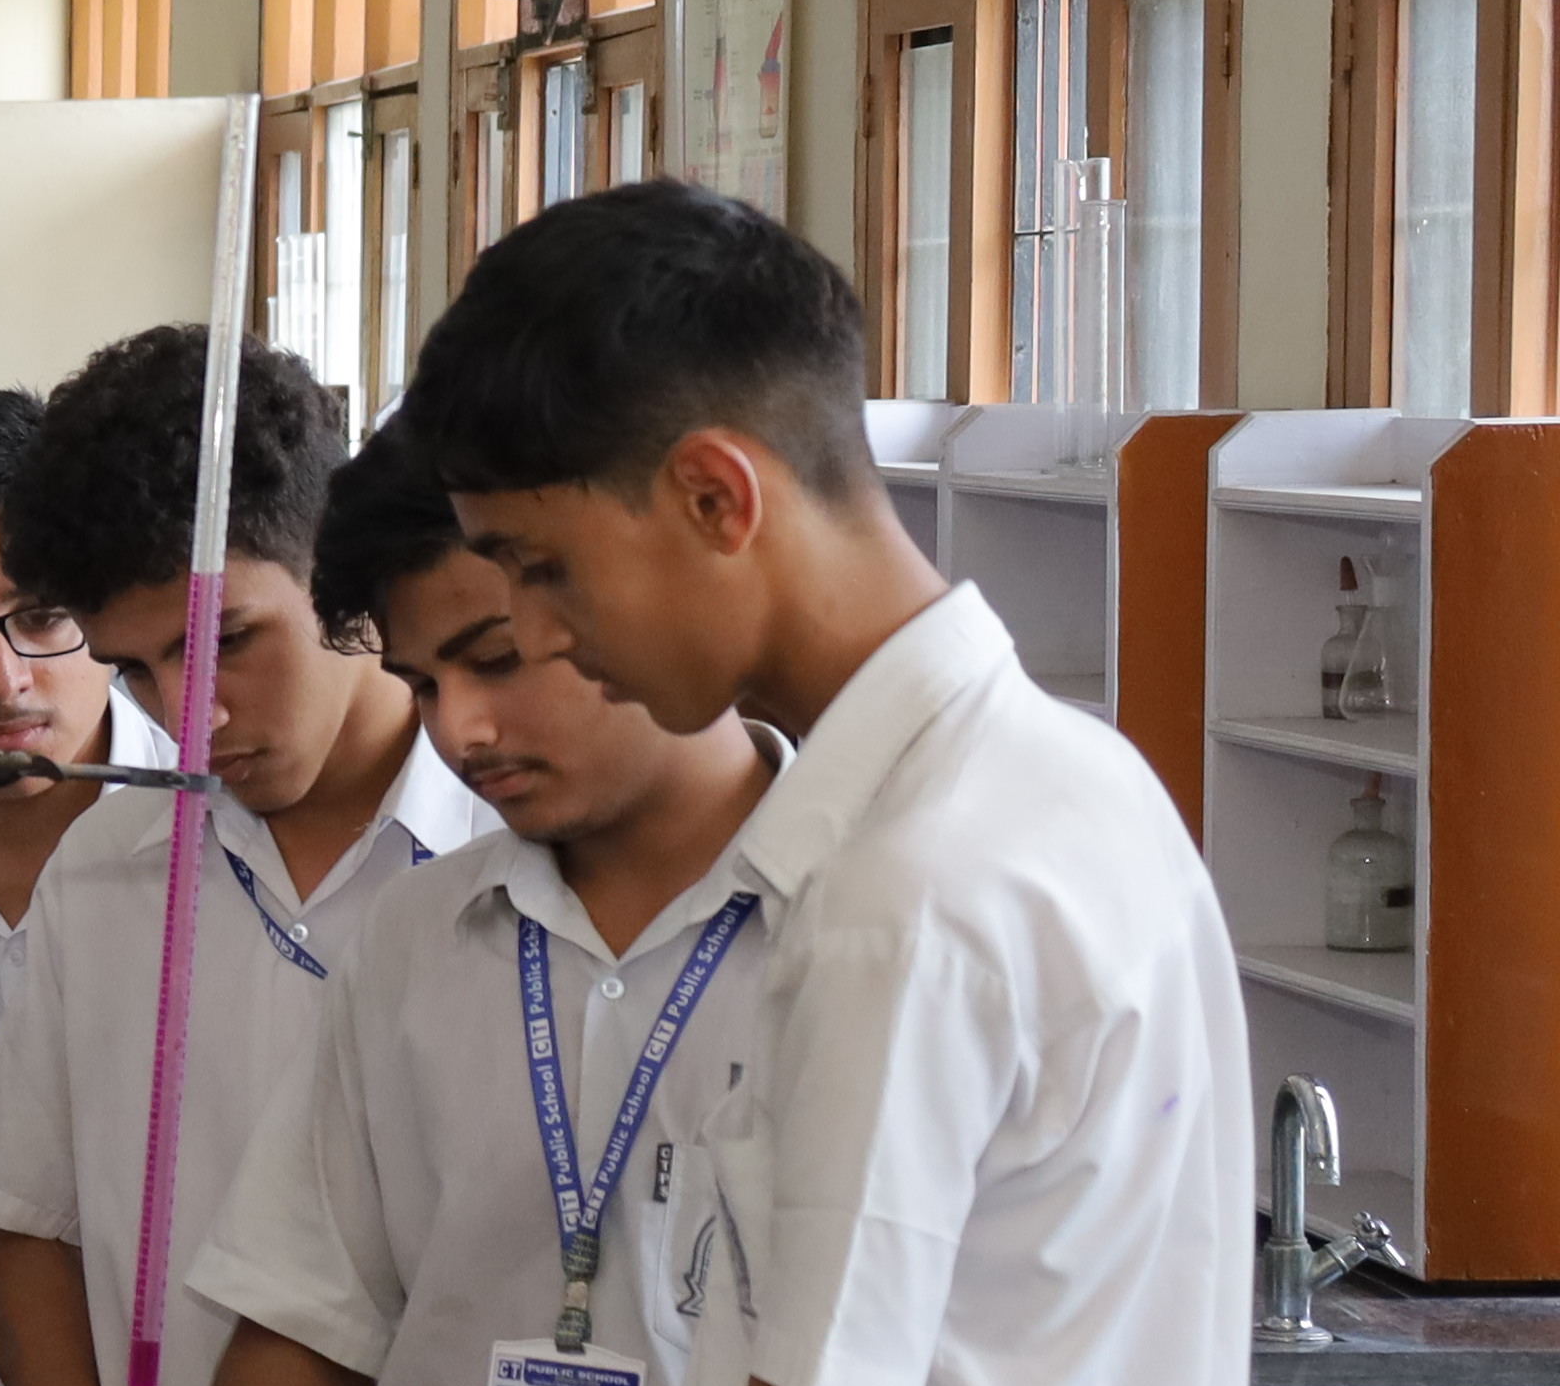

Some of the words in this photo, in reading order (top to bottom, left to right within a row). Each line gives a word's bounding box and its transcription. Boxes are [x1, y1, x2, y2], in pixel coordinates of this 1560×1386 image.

[523, 962, 545, 1014] Public
[531, 1019, 552, 1057] CT
[535, 1064, 562, 1126] School
[582, 1189, 605, 1229] CT
[599, 1128, 627, 1184] Public
[621, 1065, 653, 1126] School
[645, 1019, 677, 1062] CT
[667, 963, 706, 1019] Public
[698, 906, 739, 963] School
[553, 1128, 572, 1186] Public
[499, 1362, 520, 1379] CT
[527, 1364, 574, 1377] PUBLIC
[578, 1371, 630, 1386] SCHOOL
